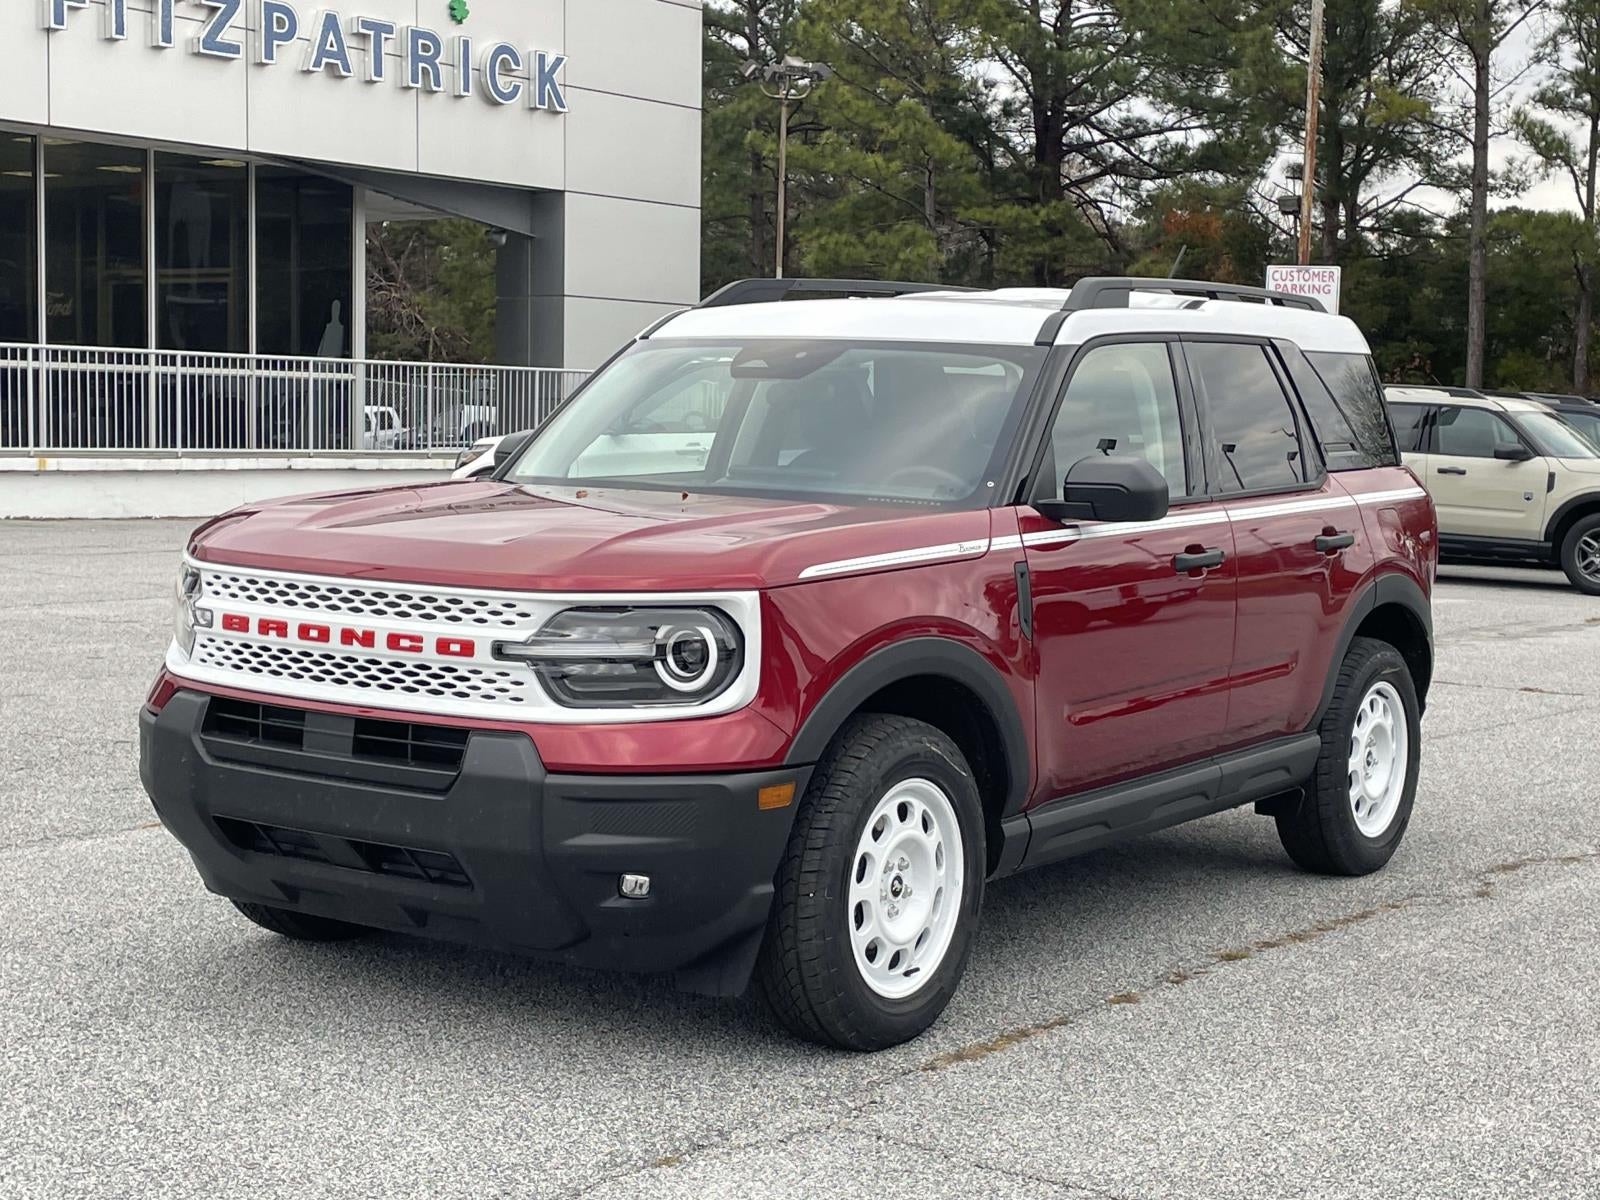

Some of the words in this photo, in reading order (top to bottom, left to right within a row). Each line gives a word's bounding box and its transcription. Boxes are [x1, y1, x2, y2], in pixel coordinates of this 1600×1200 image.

[1271, 269, 1335, 283] CUSTOMER
[1274, 283, 1332, 295] PARKING
[222, 613, 475, 658] BRONCO
